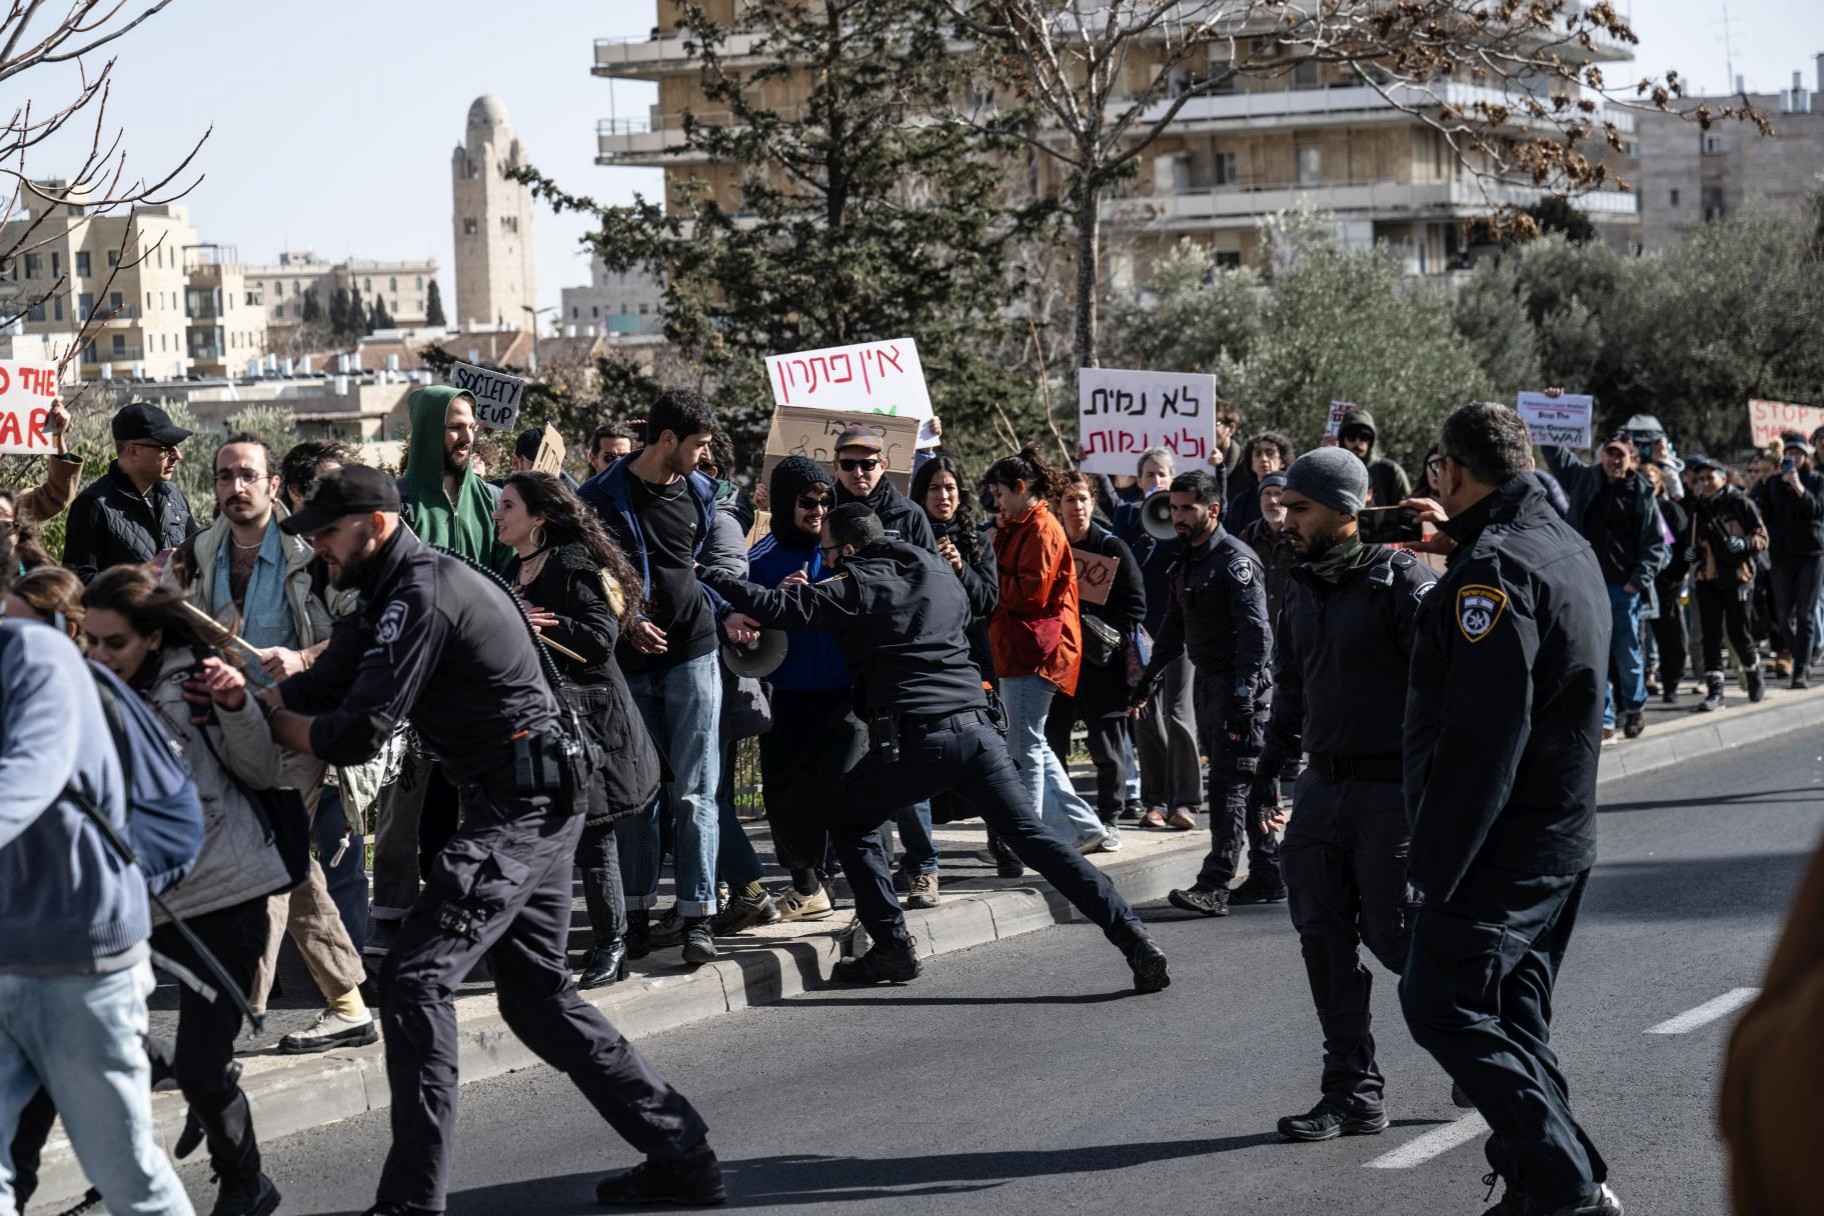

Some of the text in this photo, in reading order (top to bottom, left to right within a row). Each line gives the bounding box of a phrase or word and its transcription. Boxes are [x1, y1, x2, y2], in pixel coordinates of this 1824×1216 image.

[19, 367, 55, 397] THE
[456, 368, 519, 404] SOCIETY
[777, 345, 904, 404] אין פתרון
[491, 407, 512, 424] UP
[1083, 385, 1199, 419] לא נמית
[1755, 400, 1809, 423] STOP
[0, 407, 49, 449] AR
[1085, 427, 1206, 459] ולא נמות
